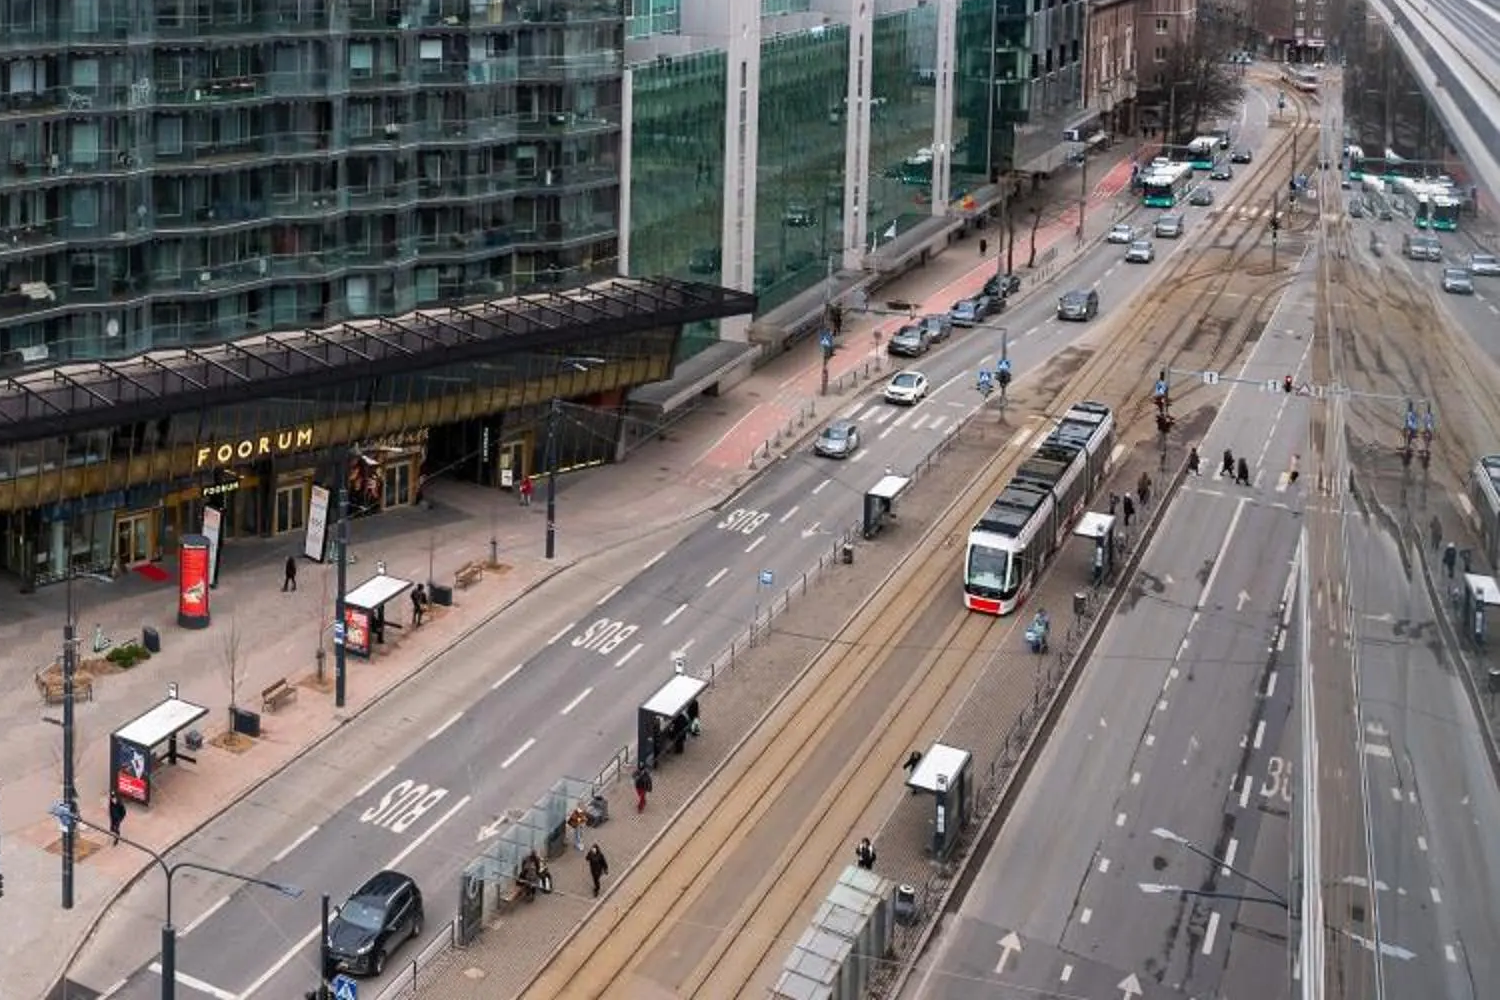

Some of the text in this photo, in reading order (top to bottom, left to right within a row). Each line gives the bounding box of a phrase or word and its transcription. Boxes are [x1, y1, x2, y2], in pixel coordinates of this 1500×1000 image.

[197, 428, 313, 467] FOORUM
[717, 509, 770, 534] BUS
[572, 618, 639, 654] BUS
[360, 779, 449, 833] BUS
